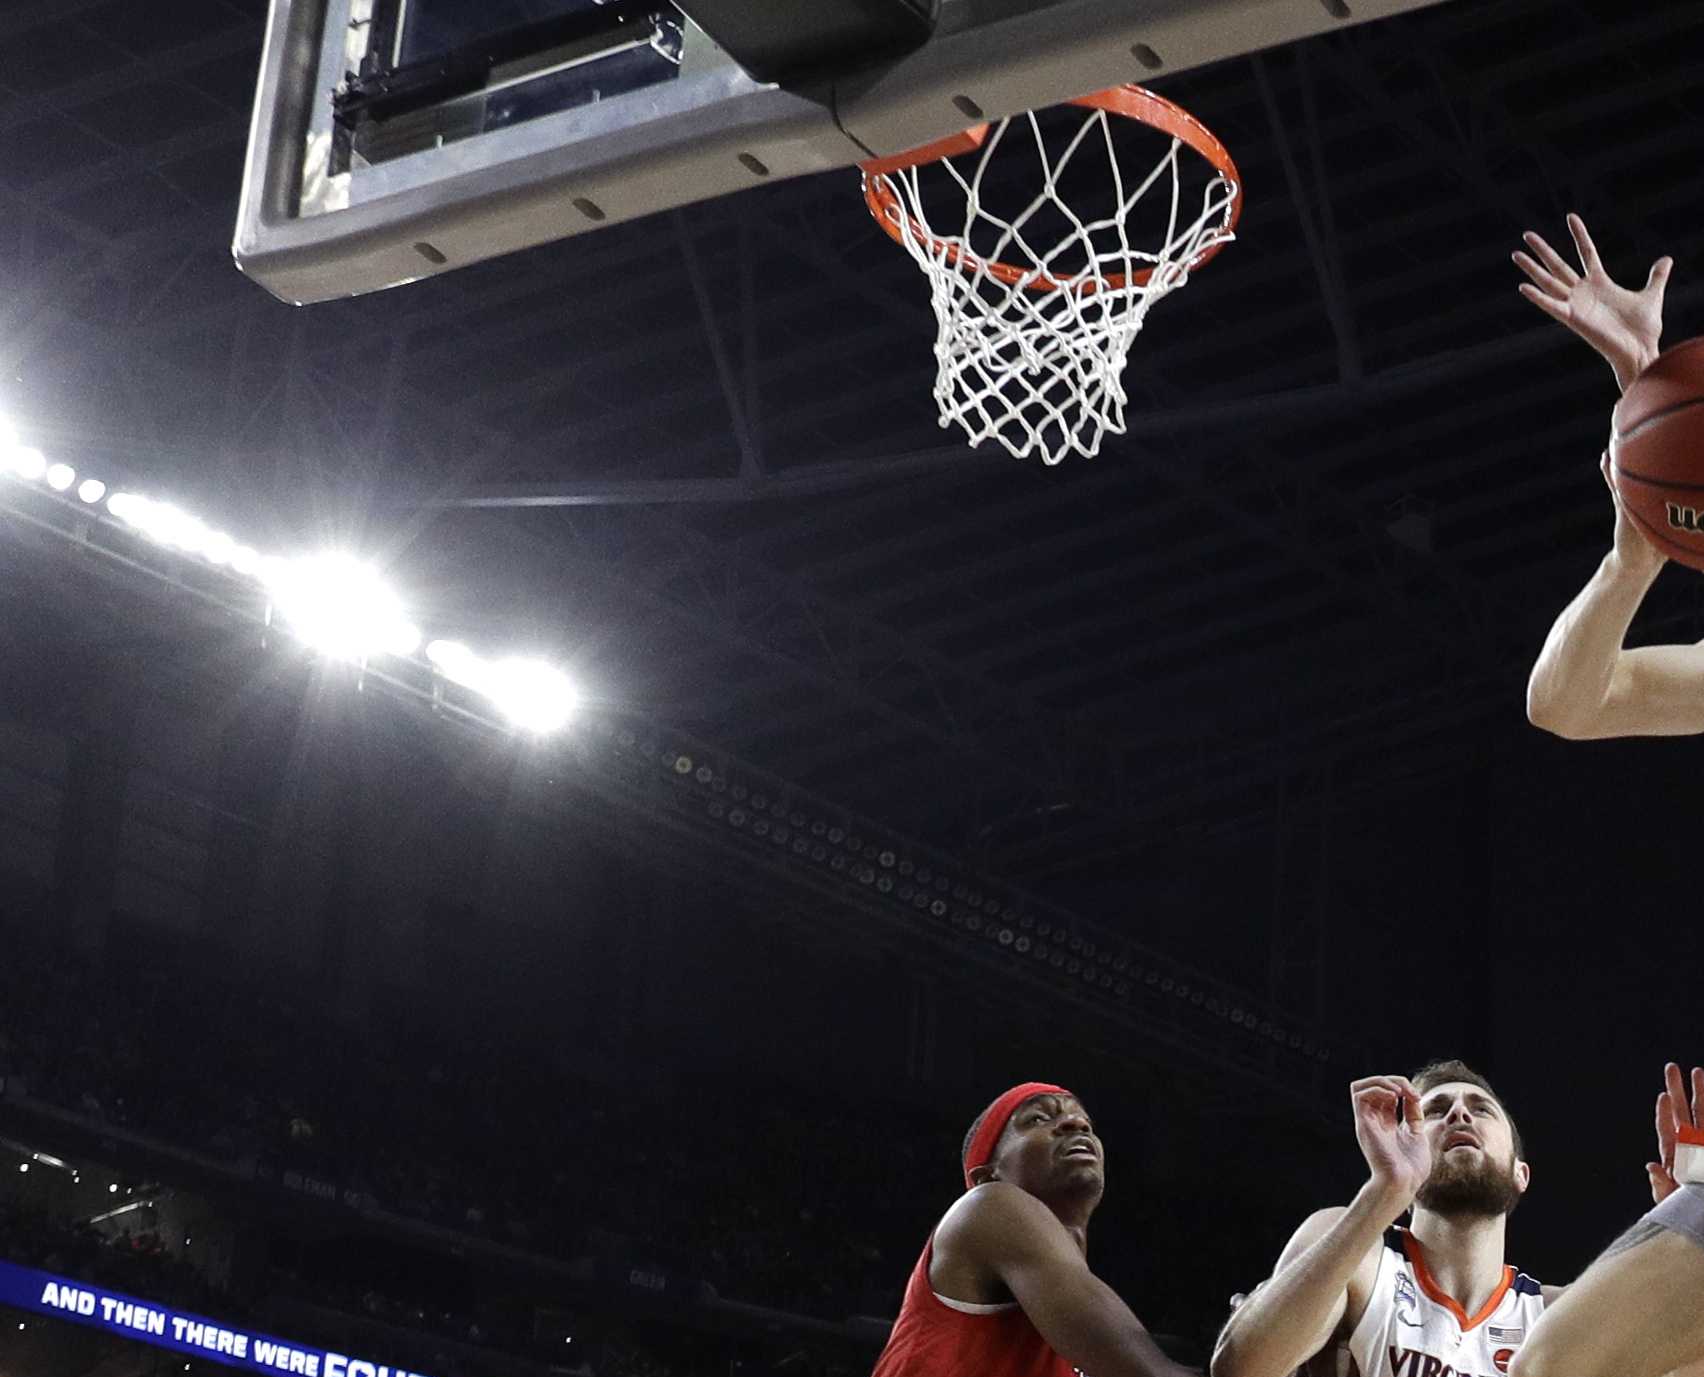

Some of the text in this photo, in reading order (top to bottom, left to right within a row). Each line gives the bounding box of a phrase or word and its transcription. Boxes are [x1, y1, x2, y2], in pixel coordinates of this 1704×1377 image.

[41, 1281, 95, 1317] AND
[101, 1297, 165, 1336] THEN
[172, 1316, 248, 1358] THERE
